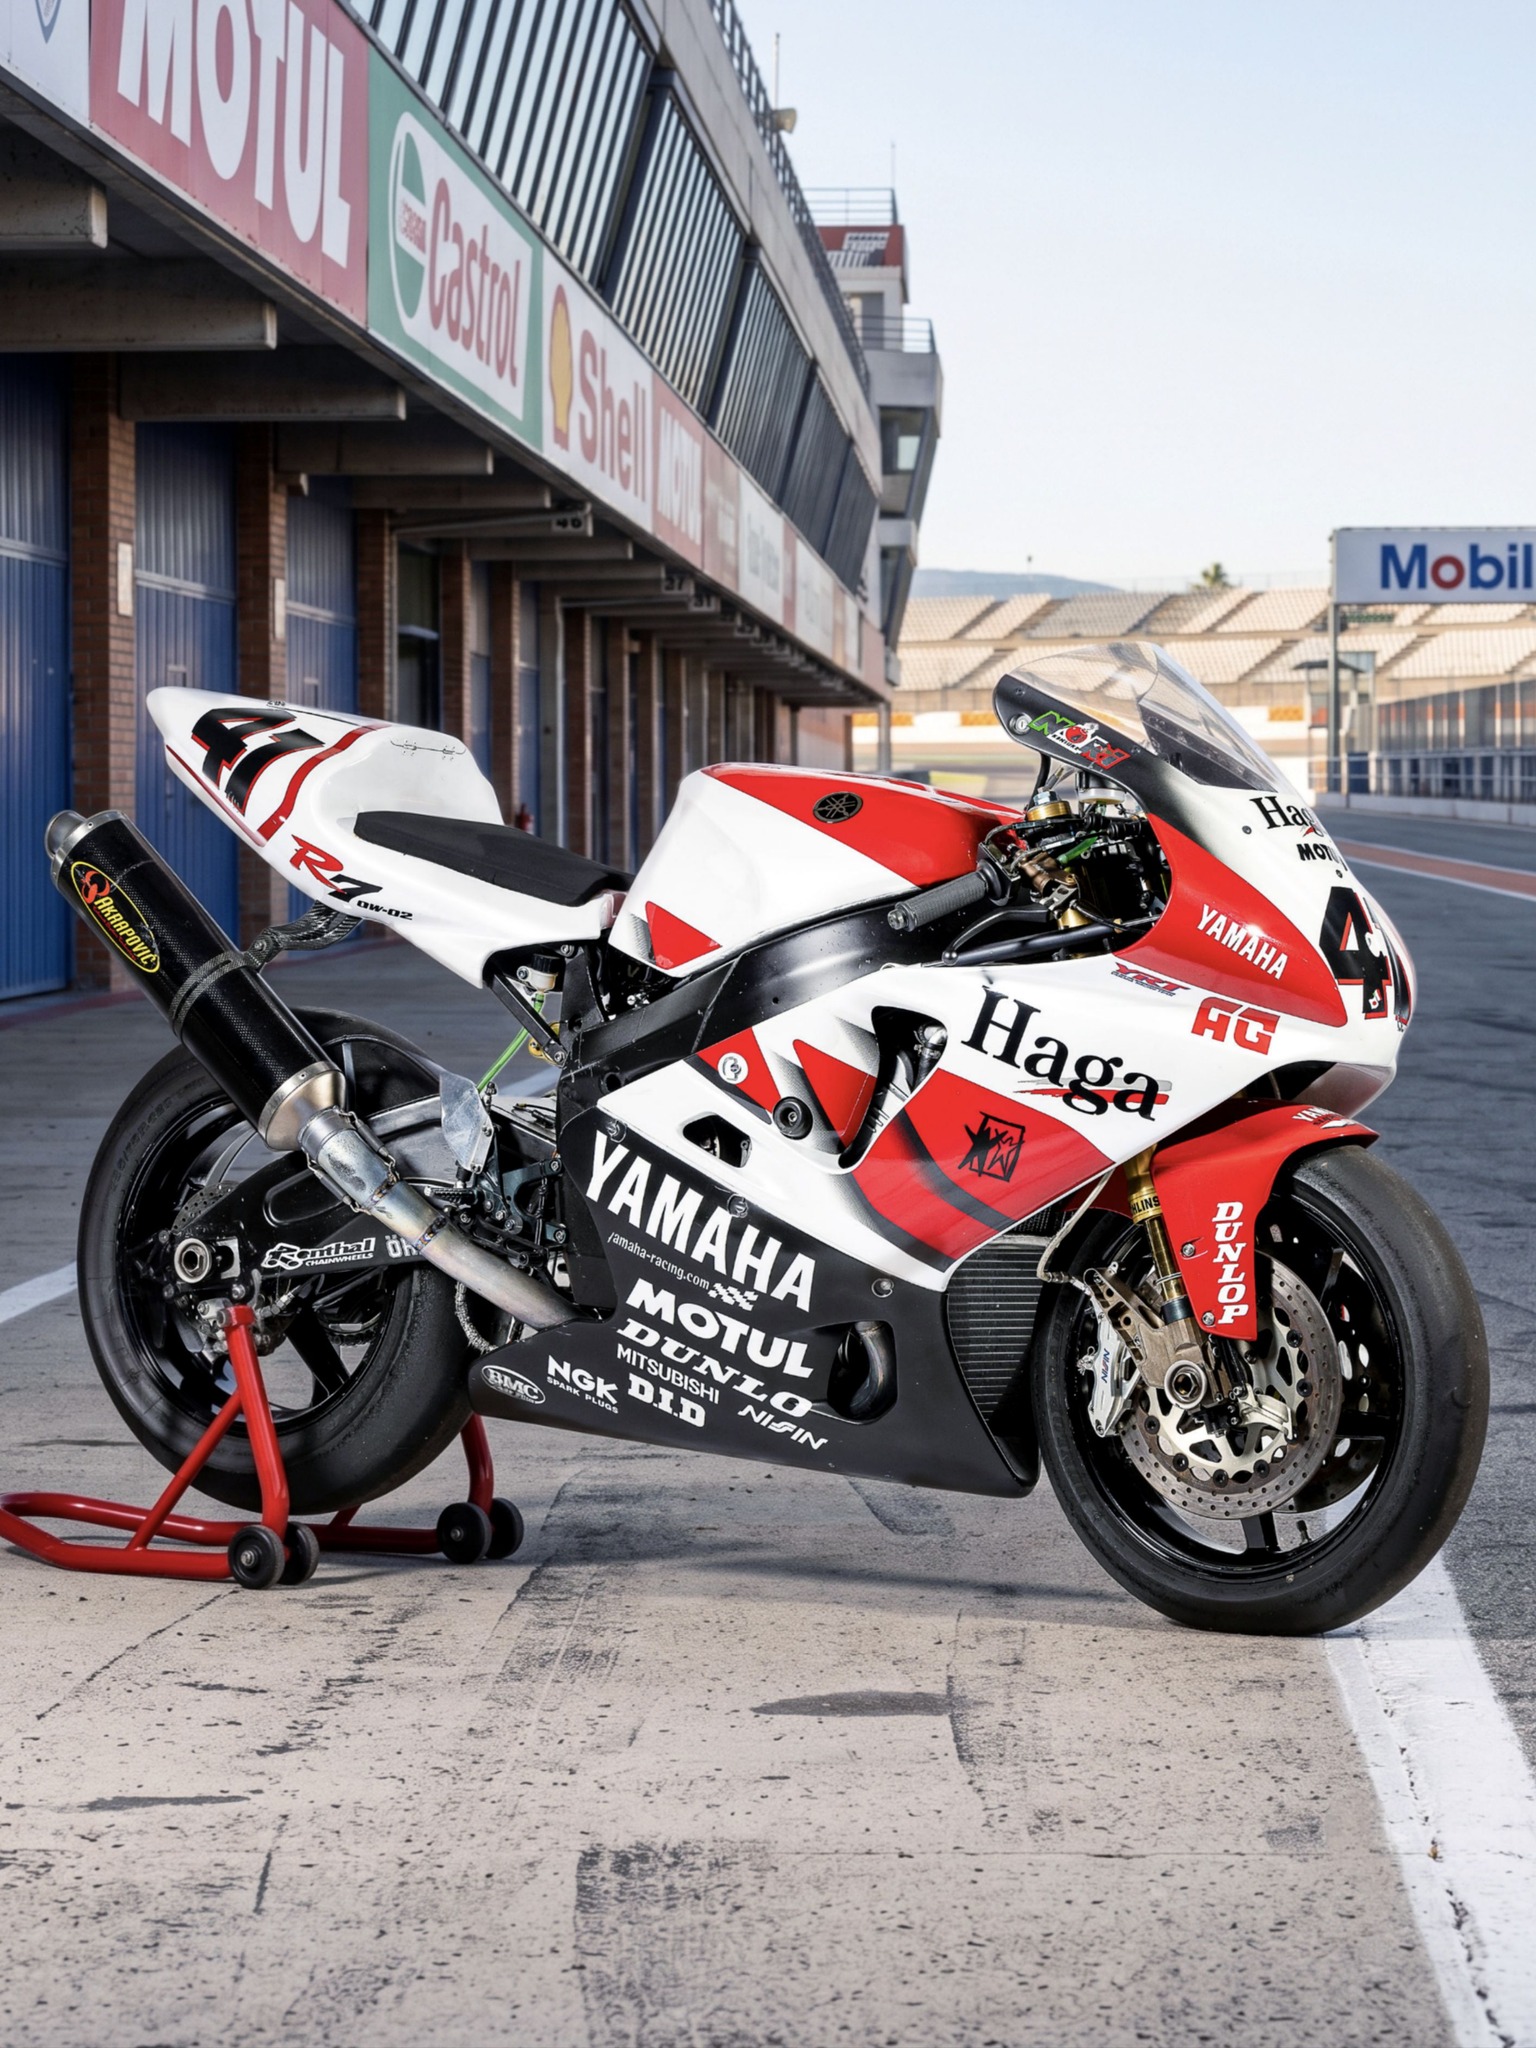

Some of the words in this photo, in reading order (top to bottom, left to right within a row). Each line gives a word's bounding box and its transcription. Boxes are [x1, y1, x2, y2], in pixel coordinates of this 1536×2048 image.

[117, 0, 350, 269] MOTUL
[429, 177, 520, 388] Castrol
[579, 329, 646, 502] Shell
[1380, 543, 1533, 590] Mobil
[192, 707, 326, 816] 41
[1250, 796, 1325, 837] Hag
[289, 834, 383, 902] R7
[1197, 903, 1289, 980] YAMAHA
[961, 985, 1156, 1122] Haga
[305, 1252, 374, 1267] CHAINWHEELS
[586, 1130, 817, 1312] YAMAHA
[1212, 1201, 1249, 1324] DUNLOP
[626, 1278, 814, 1379] MOTUL
[489, 1369, 540, 1401] BMC
[547, 1376, 580, 1397] SPARK
[585, 1393, 619, 1414] PLUGS
[548, 1355, 618, 1405] NGK
[617, 1318, 812, 1418] DUNLO
[617, 1343, 719, 1404] MITSUBISHI
[628, 1373, 706, 1428] D.I.D
